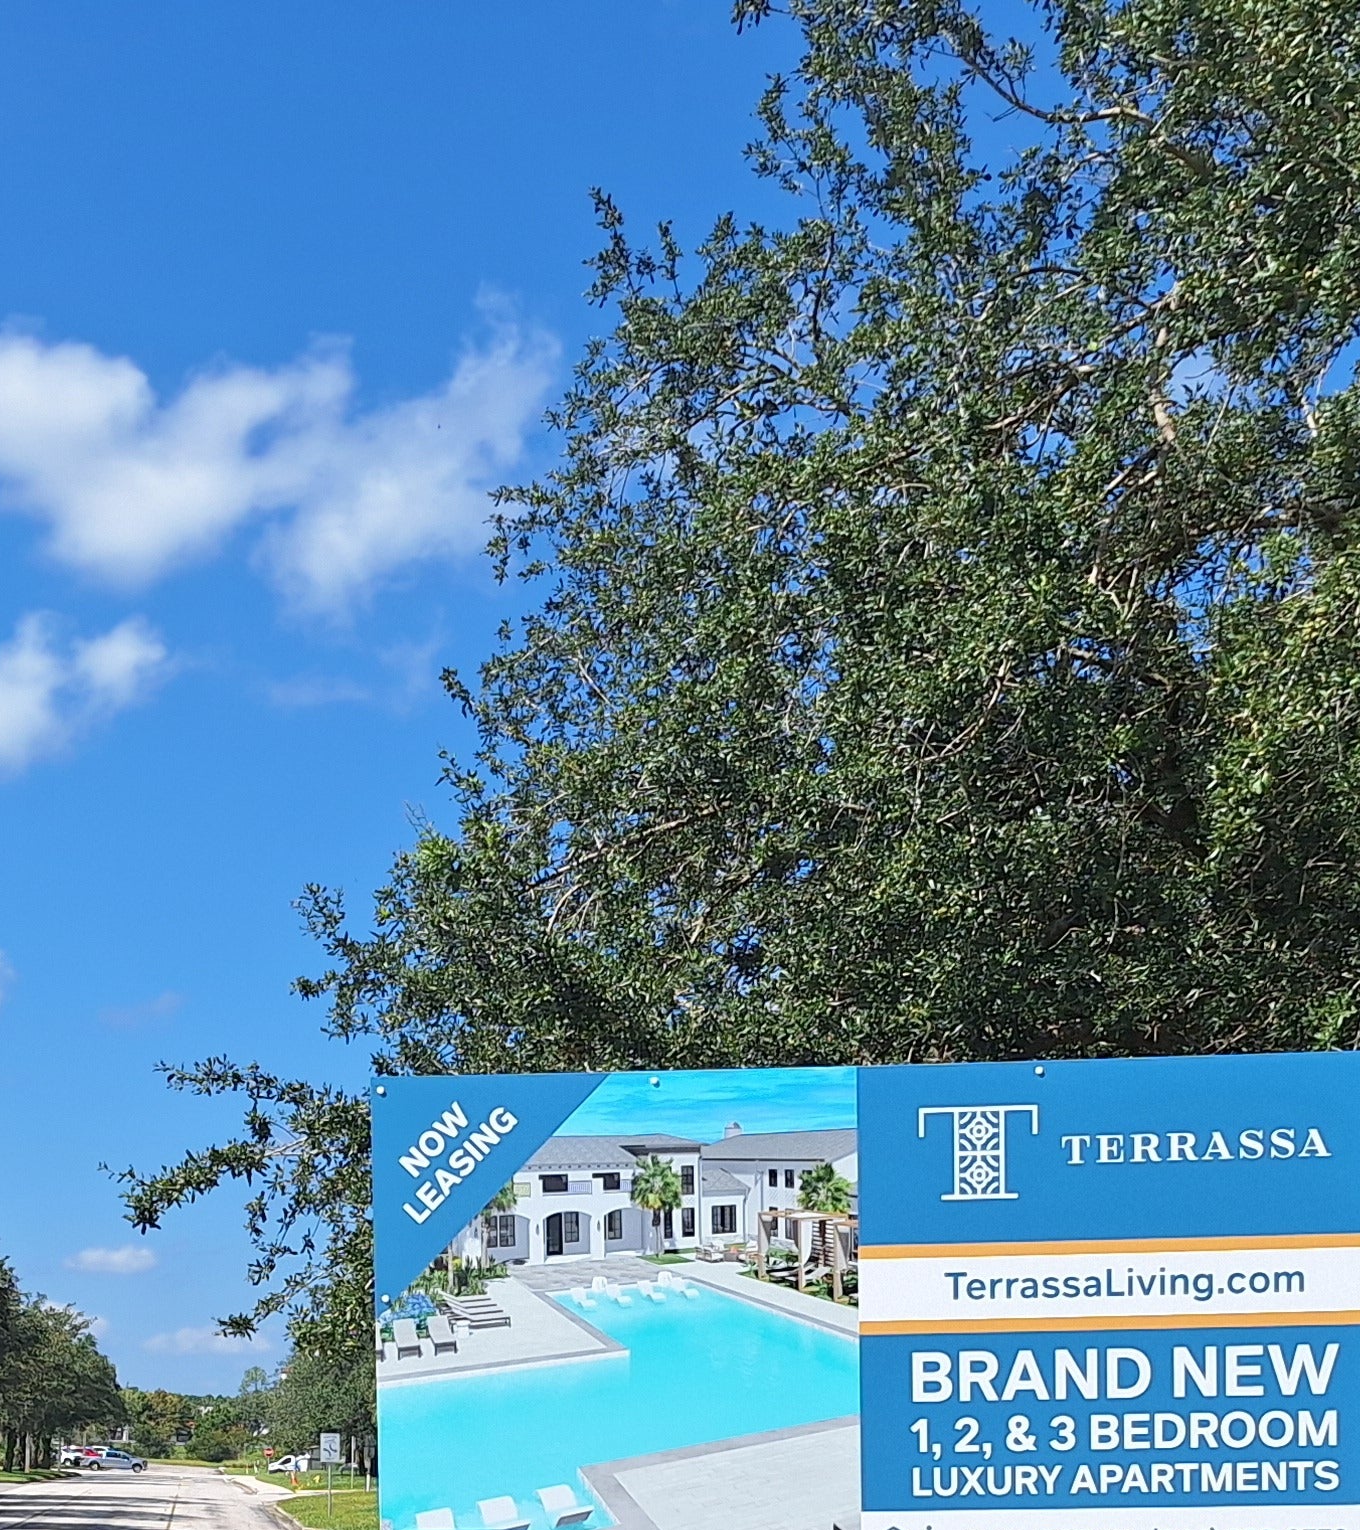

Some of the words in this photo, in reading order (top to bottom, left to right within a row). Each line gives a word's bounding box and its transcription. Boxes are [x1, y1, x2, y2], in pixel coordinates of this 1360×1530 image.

[398, 1100, 469, 1179] NOW
[1060, 1128, 1332, 1165] TERRASSA
[402, 1106, 519, 1225] LEASING
[944, 1268, 1306, 1301] TerrassaLiving.com
[911, 1347, 1152, 1403] BRAND
[1172, 1342, 1340, 1398] NEW
[909, 1418, 941, 1460] 1,
[953, 1416, 993, 1460] 2,
[1005, 1414, 1038, 1452] &
[1048, 1414, 1077, 1451] 3
[1089, 1409, 1339, 1452] BEDROOM
[911, 1464, 1064, 1498] LUXURY
[1069, 1460, 1341, 1495] APARTMENTS
